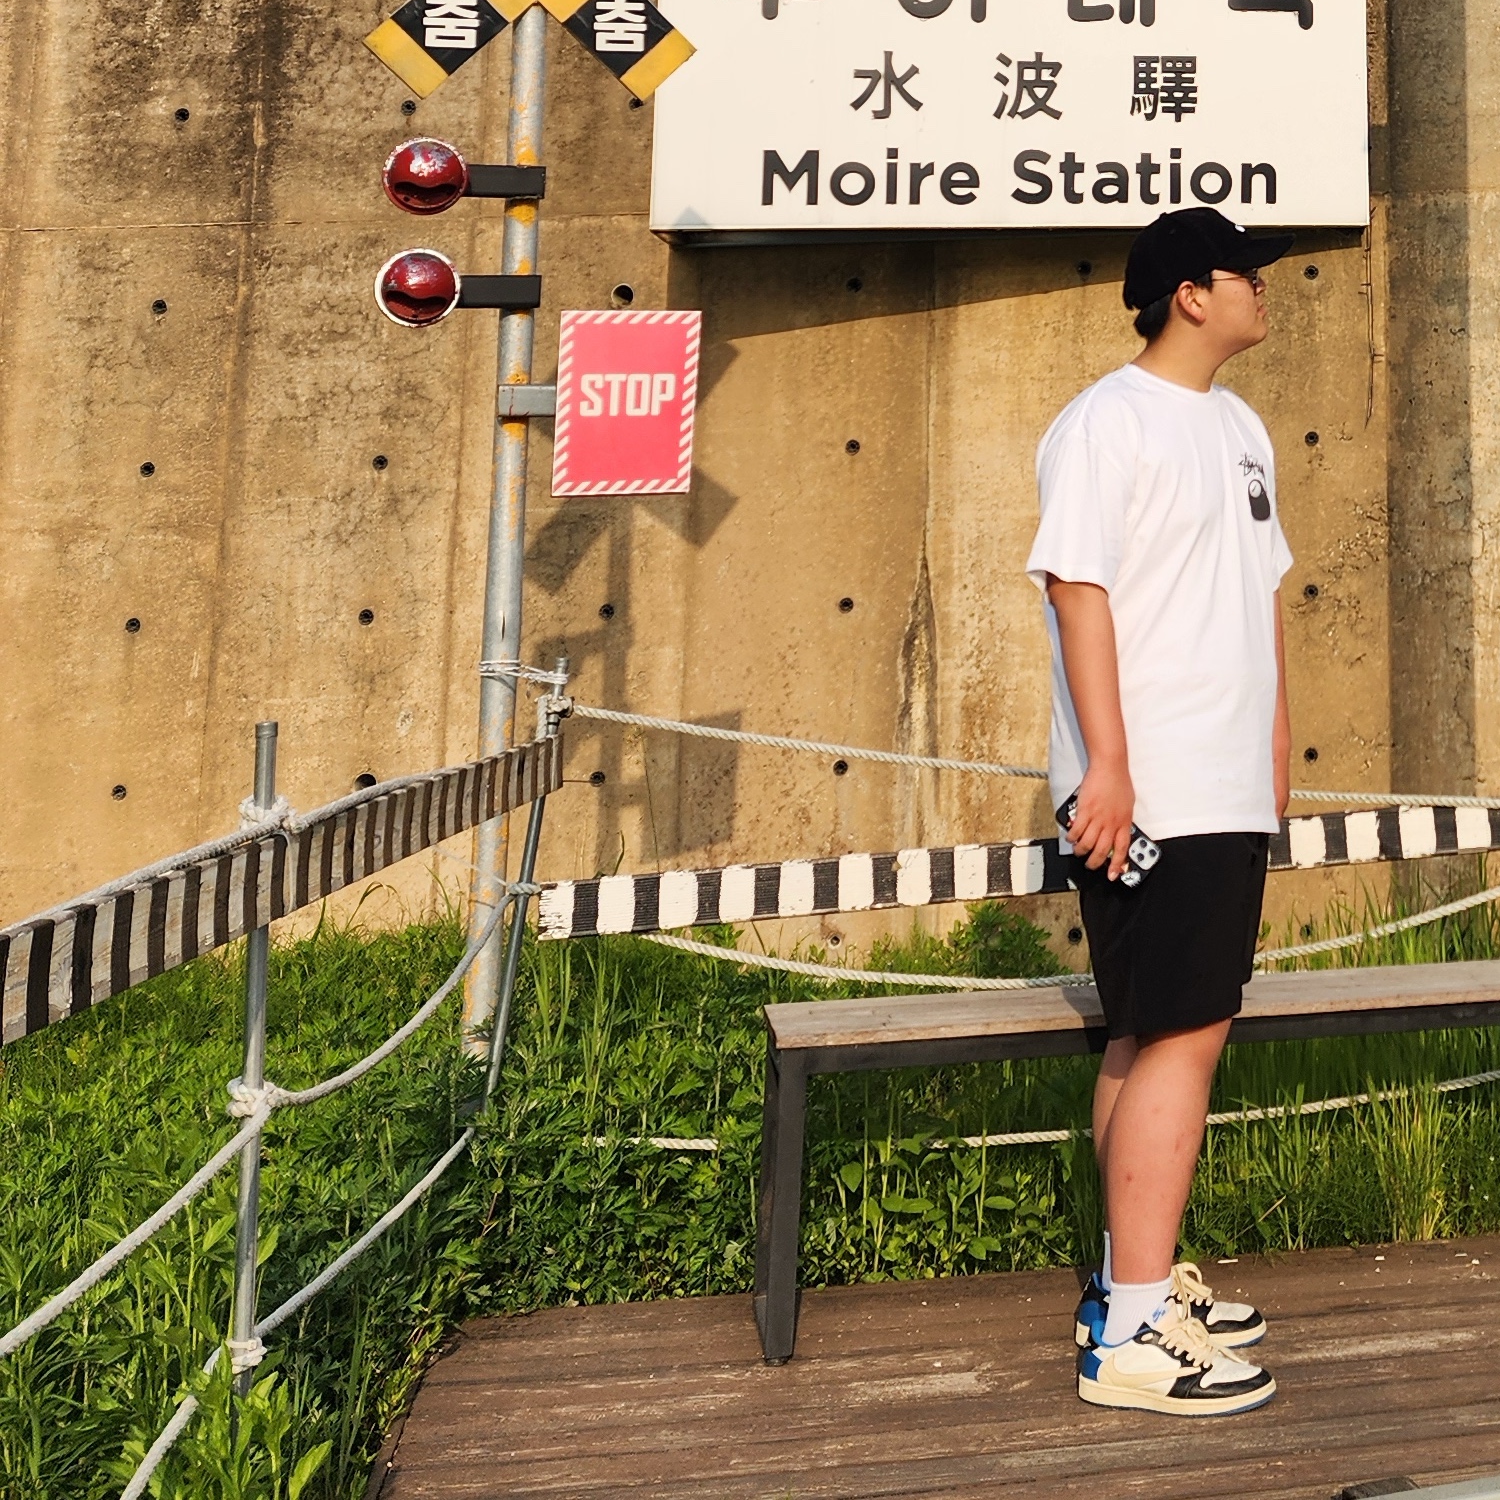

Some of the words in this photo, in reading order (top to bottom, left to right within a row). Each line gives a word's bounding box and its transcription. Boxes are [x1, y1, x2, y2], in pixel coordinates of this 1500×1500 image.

[761, 147, 981, 206] Moire
[1010, 148, 1277, 207] Station
[579, 373, 676, 417] STOP
